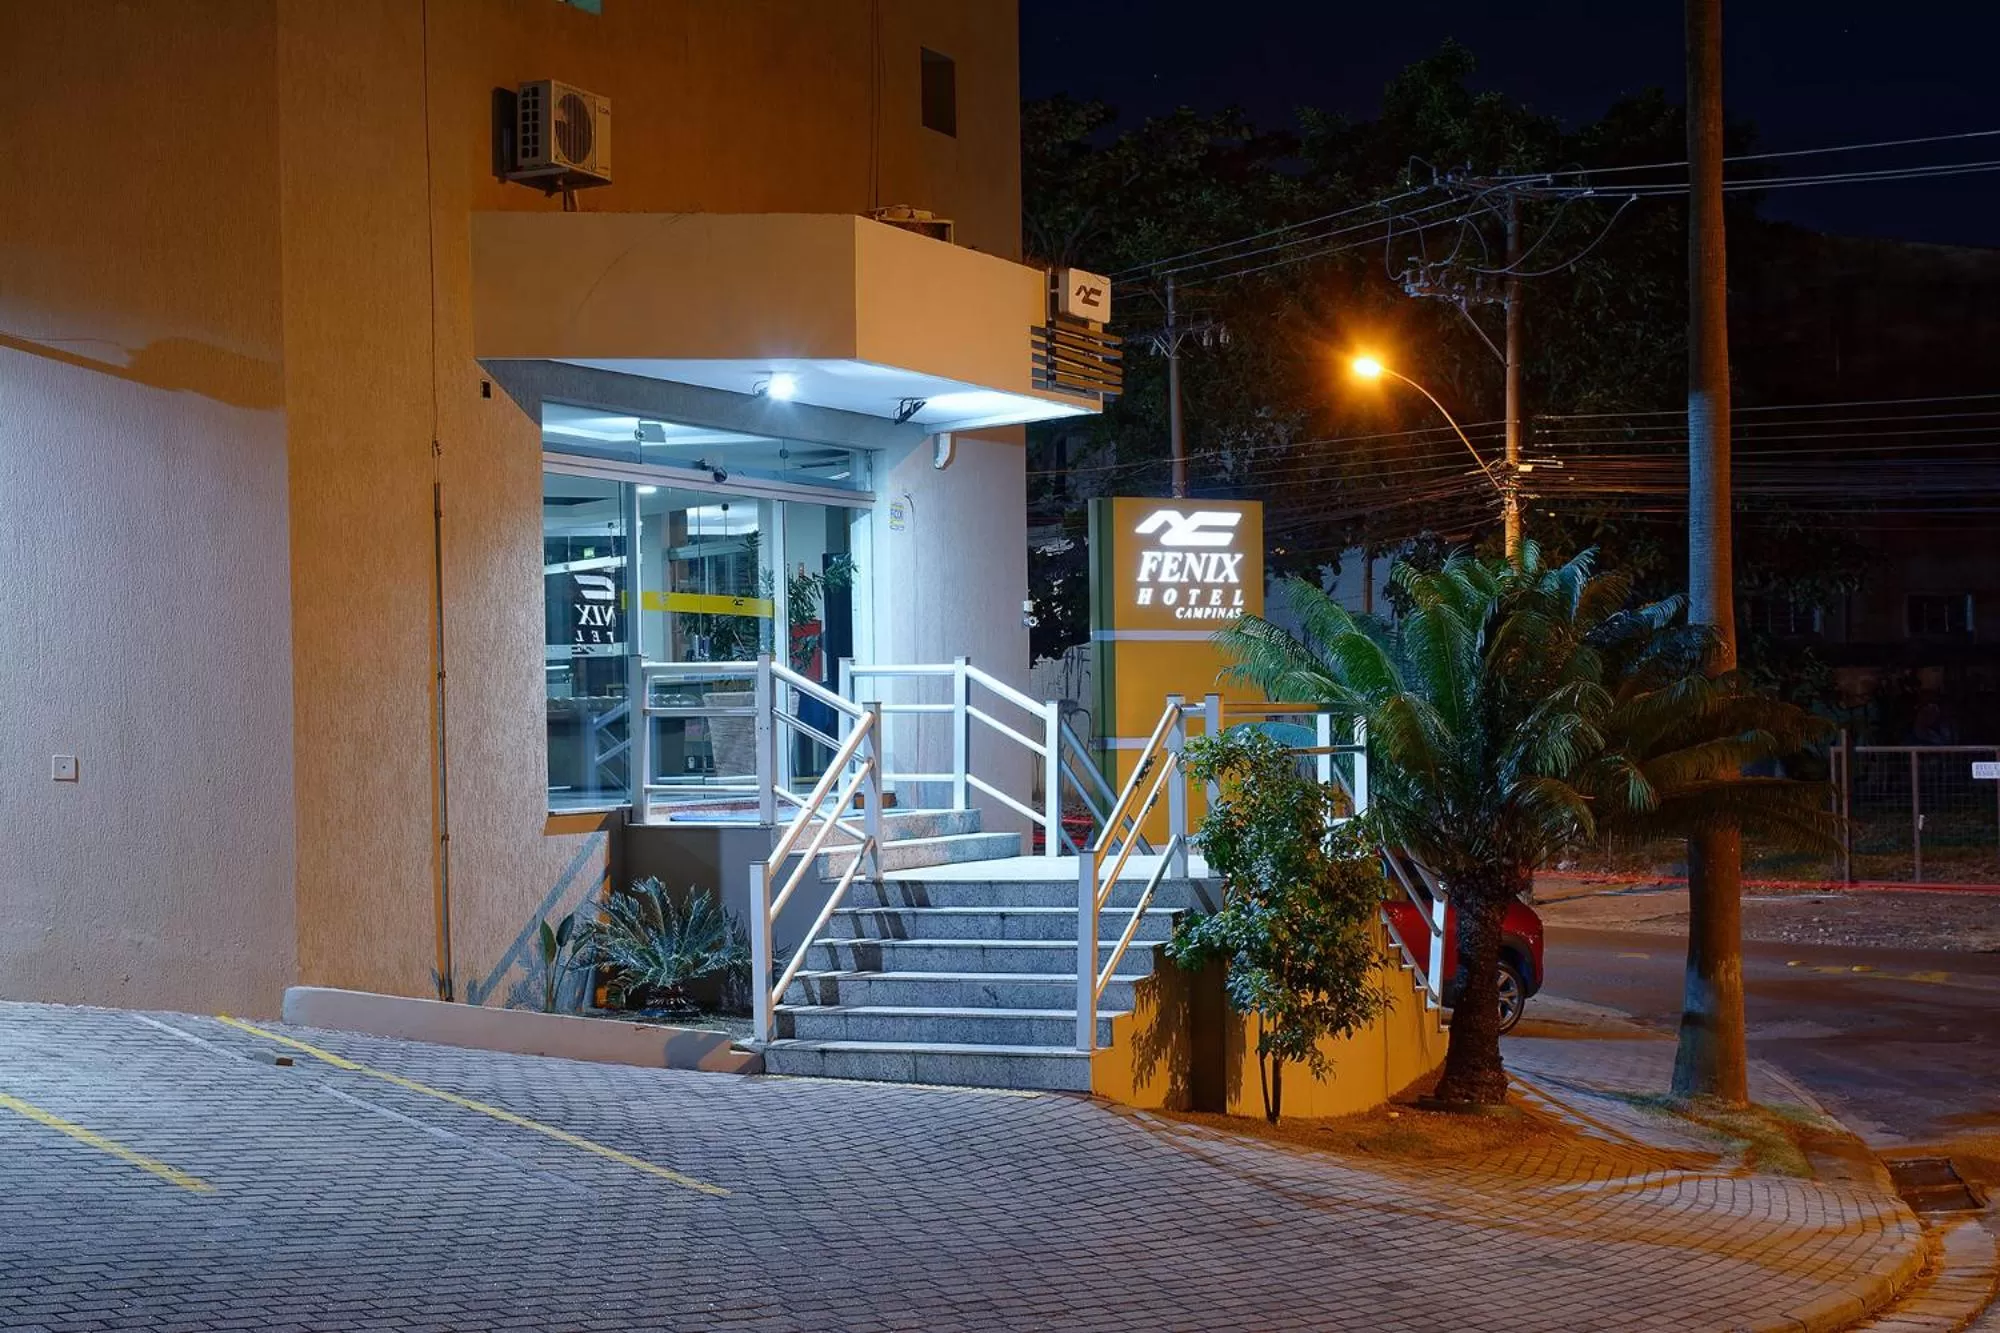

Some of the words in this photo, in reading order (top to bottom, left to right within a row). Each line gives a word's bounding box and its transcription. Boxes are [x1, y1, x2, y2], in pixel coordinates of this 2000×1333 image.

[1136, 551, 1244, 583] FENIX
[1136, 588, 1244, 606] HOTEL
[1175, 607, 1243, 620] CAMPINAS
